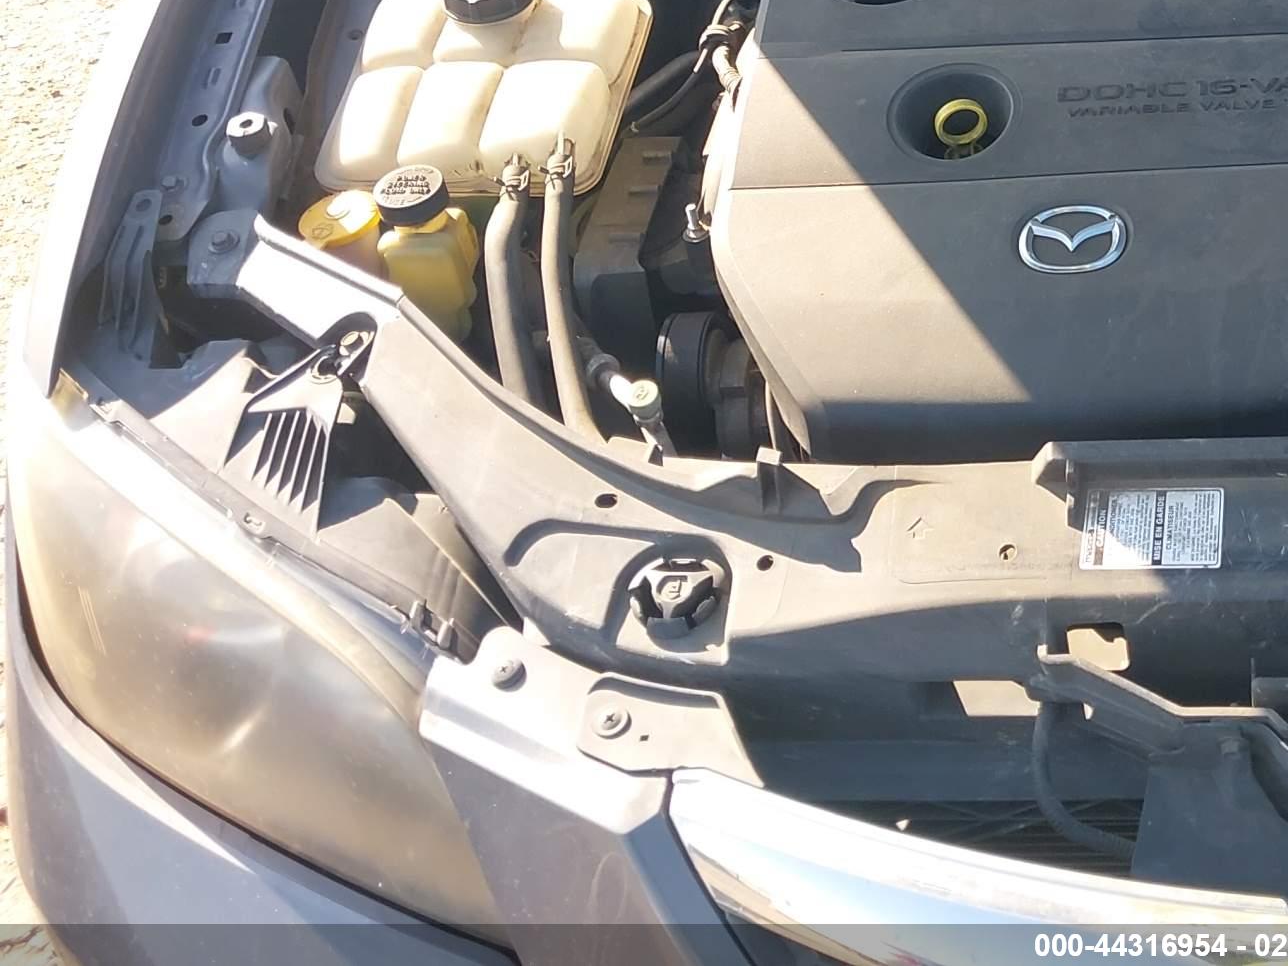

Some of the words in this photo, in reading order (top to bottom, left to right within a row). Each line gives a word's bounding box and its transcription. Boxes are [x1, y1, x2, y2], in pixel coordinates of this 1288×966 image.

[1057, 82, 1188, 103] DOHC
[1067, 102, 1190, 118] VARIABLE
[1200, 98, 1277, 113] VALVE
[1156, 495, 1166, 525] GARDE
[1155, 526, 1163, 539] EN
[1152, 539, 1162, 562] MISE
